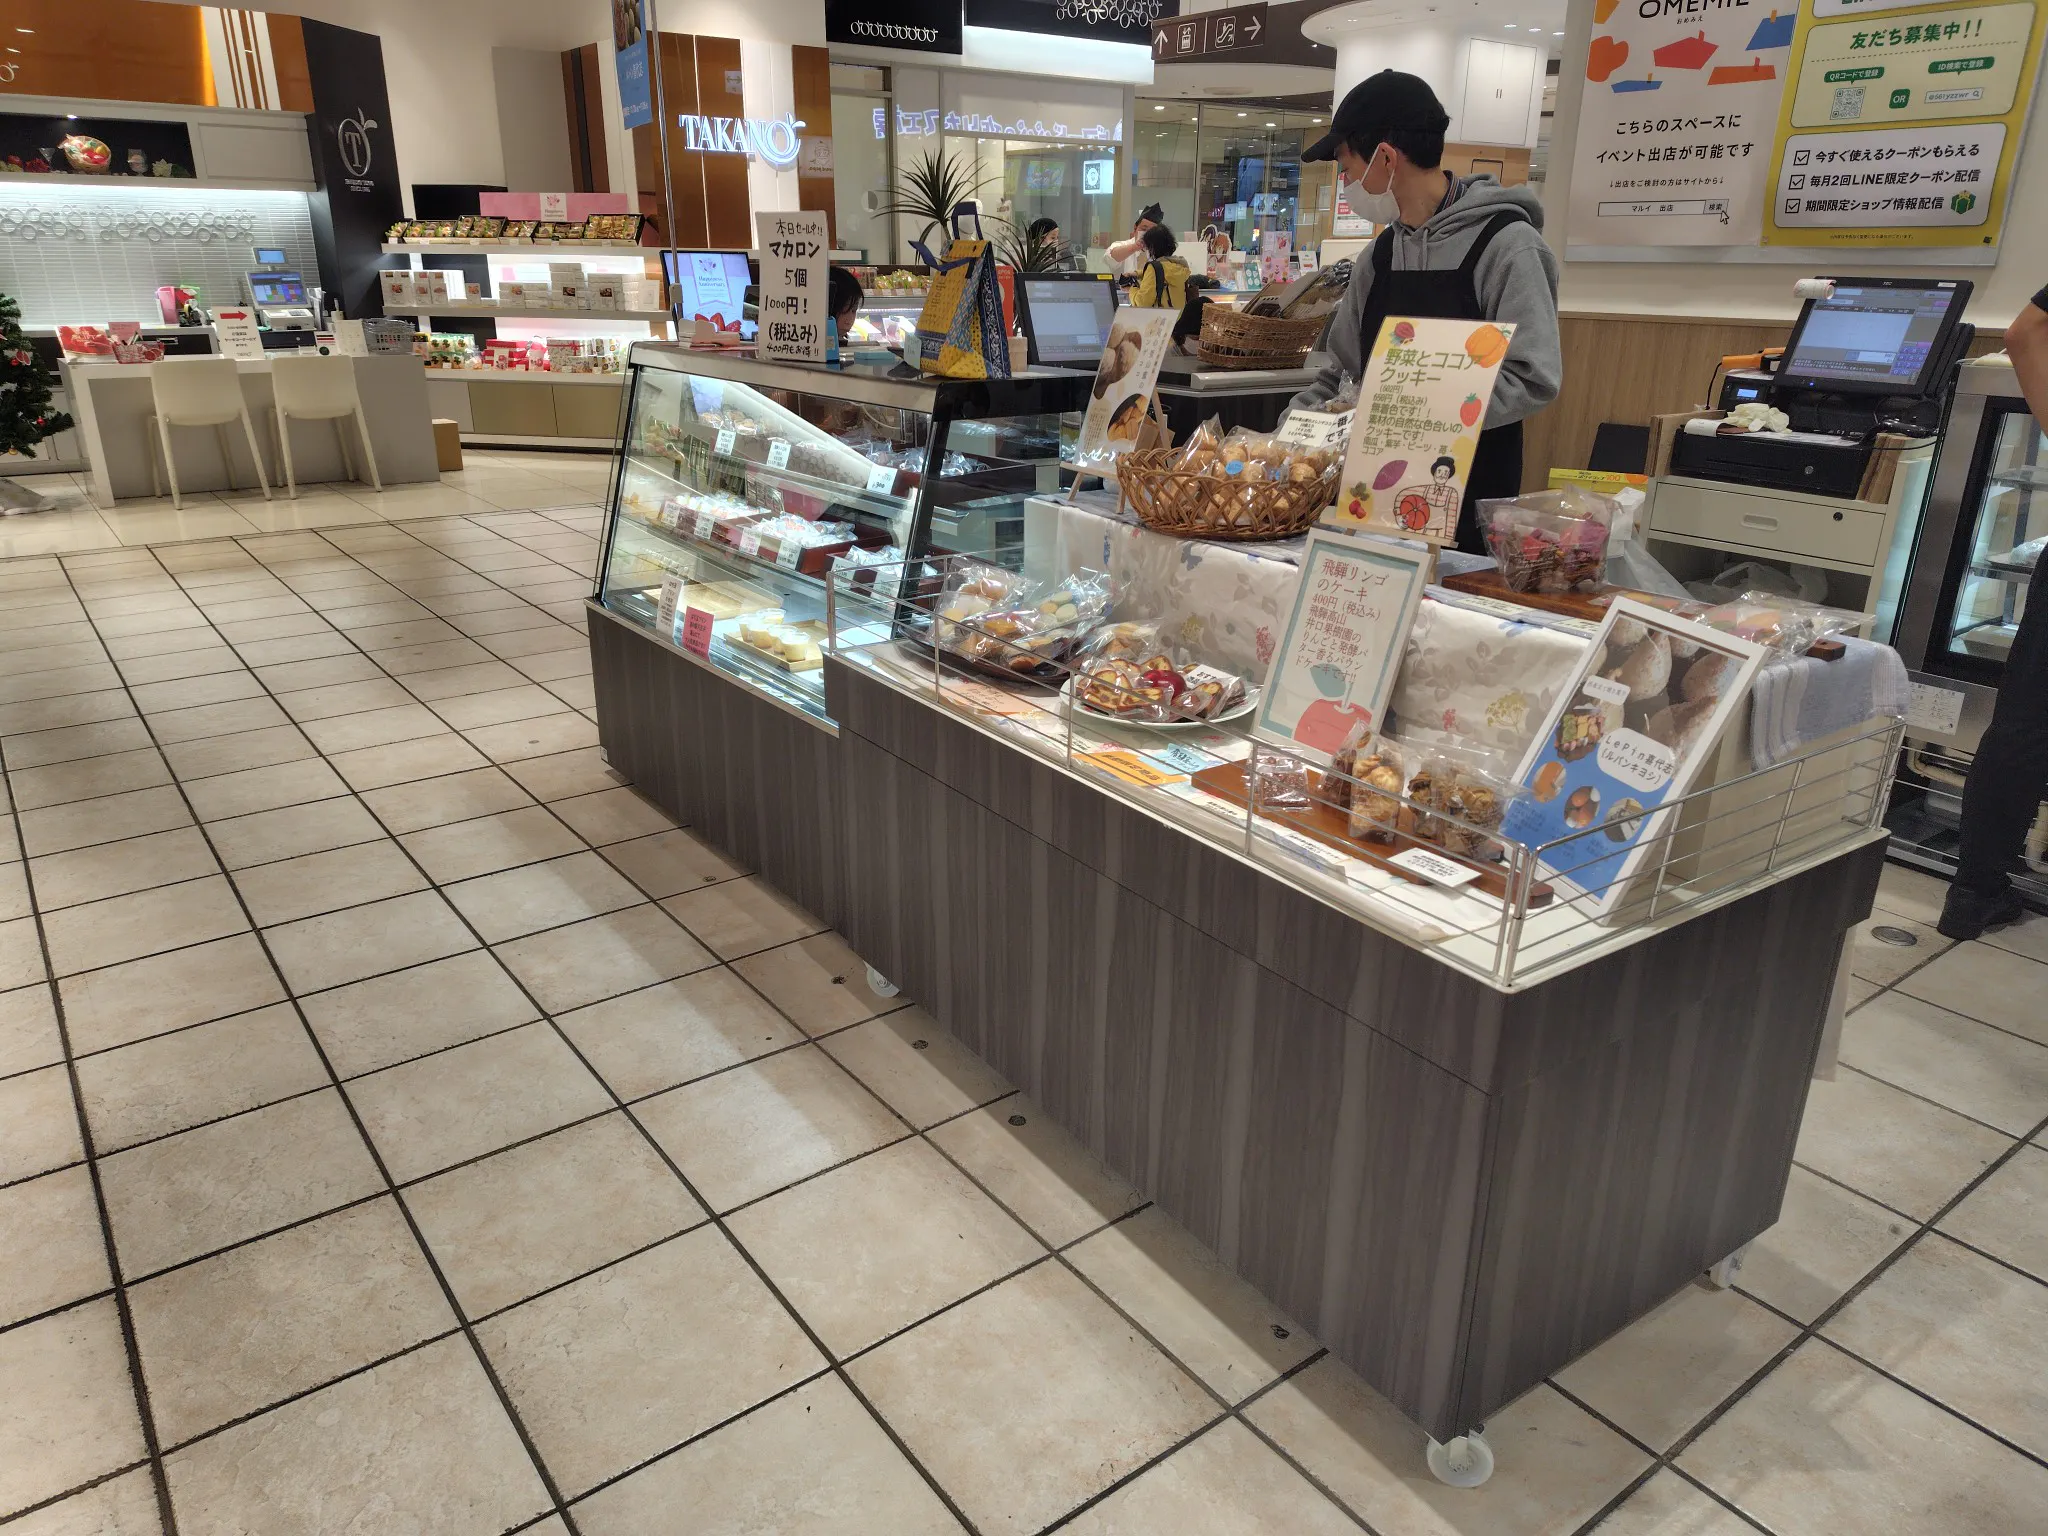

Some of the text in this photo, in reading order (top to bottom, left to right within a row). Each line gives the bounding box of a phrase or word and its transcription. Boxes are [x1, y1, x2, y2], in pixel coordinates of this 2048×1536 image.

[1829, 68, 1879, 81] QRコードで登録
[1938, 59, 1984, 71] ID検索で登録
[1892, 94, 1906, 104] OR
[1616, 114, 1742, 135] こちらのスペースに
[679, 112, 807, 165] TAKANO
[1596, 142, 1755, 163] イベント出店が可能です
[1815, 144, 1980, 163] 今すぐ使えるクーポンもらえる
[1810, 169, 1982, 188] 毎月2回LINE限定クーポン配信
[1659, 204, 1674, 212] 出店
[1708, 203, 1723, 211] 検索
[1805, 196, 1945, 212] 期間限定ショップ情報配信
[769, 240, 820, 259] マカロン
[785, 267, 807, 287] 5個
[768, 322, 818, 344] (税込み)
[1384, 348, 1484, 370] 野菜とココア
[1380, 366, 1441, 387] クッキー
[1367, 415, 1463, 433] 素材の自然な色合いの
[1361, 446, 1384, 456] ココア
[1322, 558, 1390, 586] 飛騨リンゴ
[1317, 578, 1367, 602] のケーキ
[1312, 593, 1339, 609] 400円
[1309, 604, 1346, 625] 飛騨高山
[1304, 616, 1362, 643] 井口果樹園の
[1302, 631, 1368, 657] りんごと発酵バ
